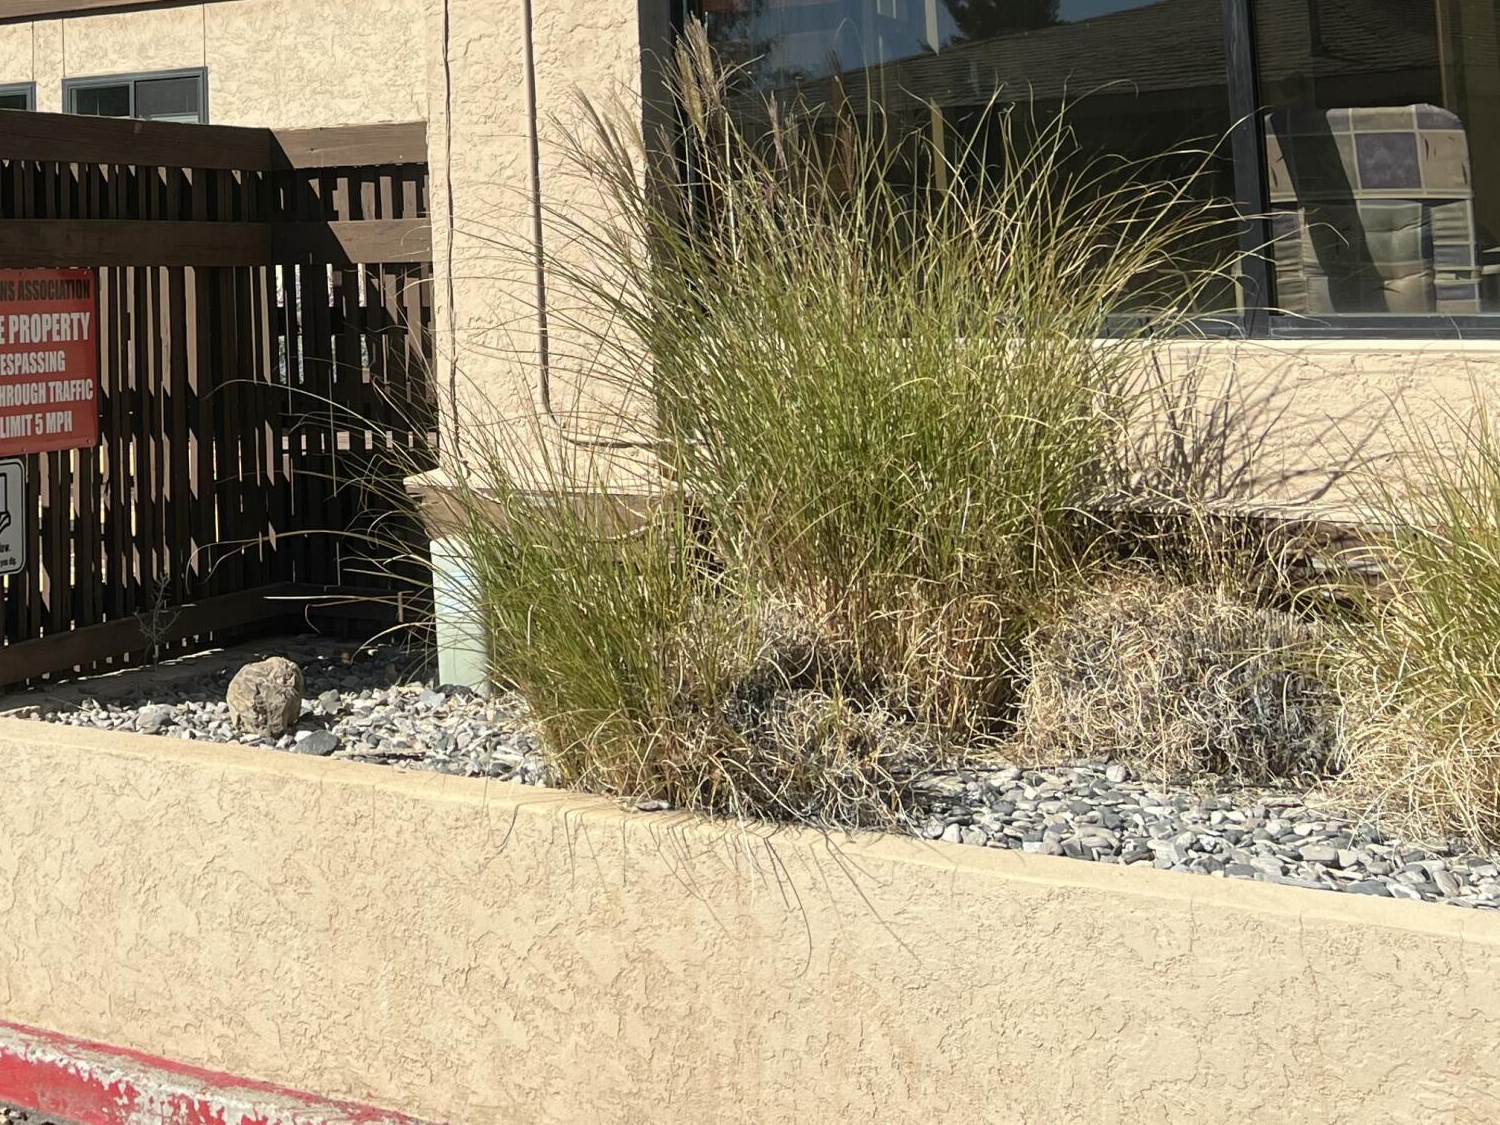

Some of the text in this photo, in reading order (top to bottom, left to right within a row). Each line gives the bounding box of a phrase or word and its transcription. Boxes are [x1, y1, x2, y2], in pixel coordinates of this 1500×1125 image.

[18, 278, 91, 301] ASSOCIATION
[8, 312, 91, 344] PROPERTY
[48, 378, 93, 403] TRAFFIC
[0, 413, 33, 439] LIMIT
[35, 412, 43, 435] 5
[45, 410, 73, 434] MPH
